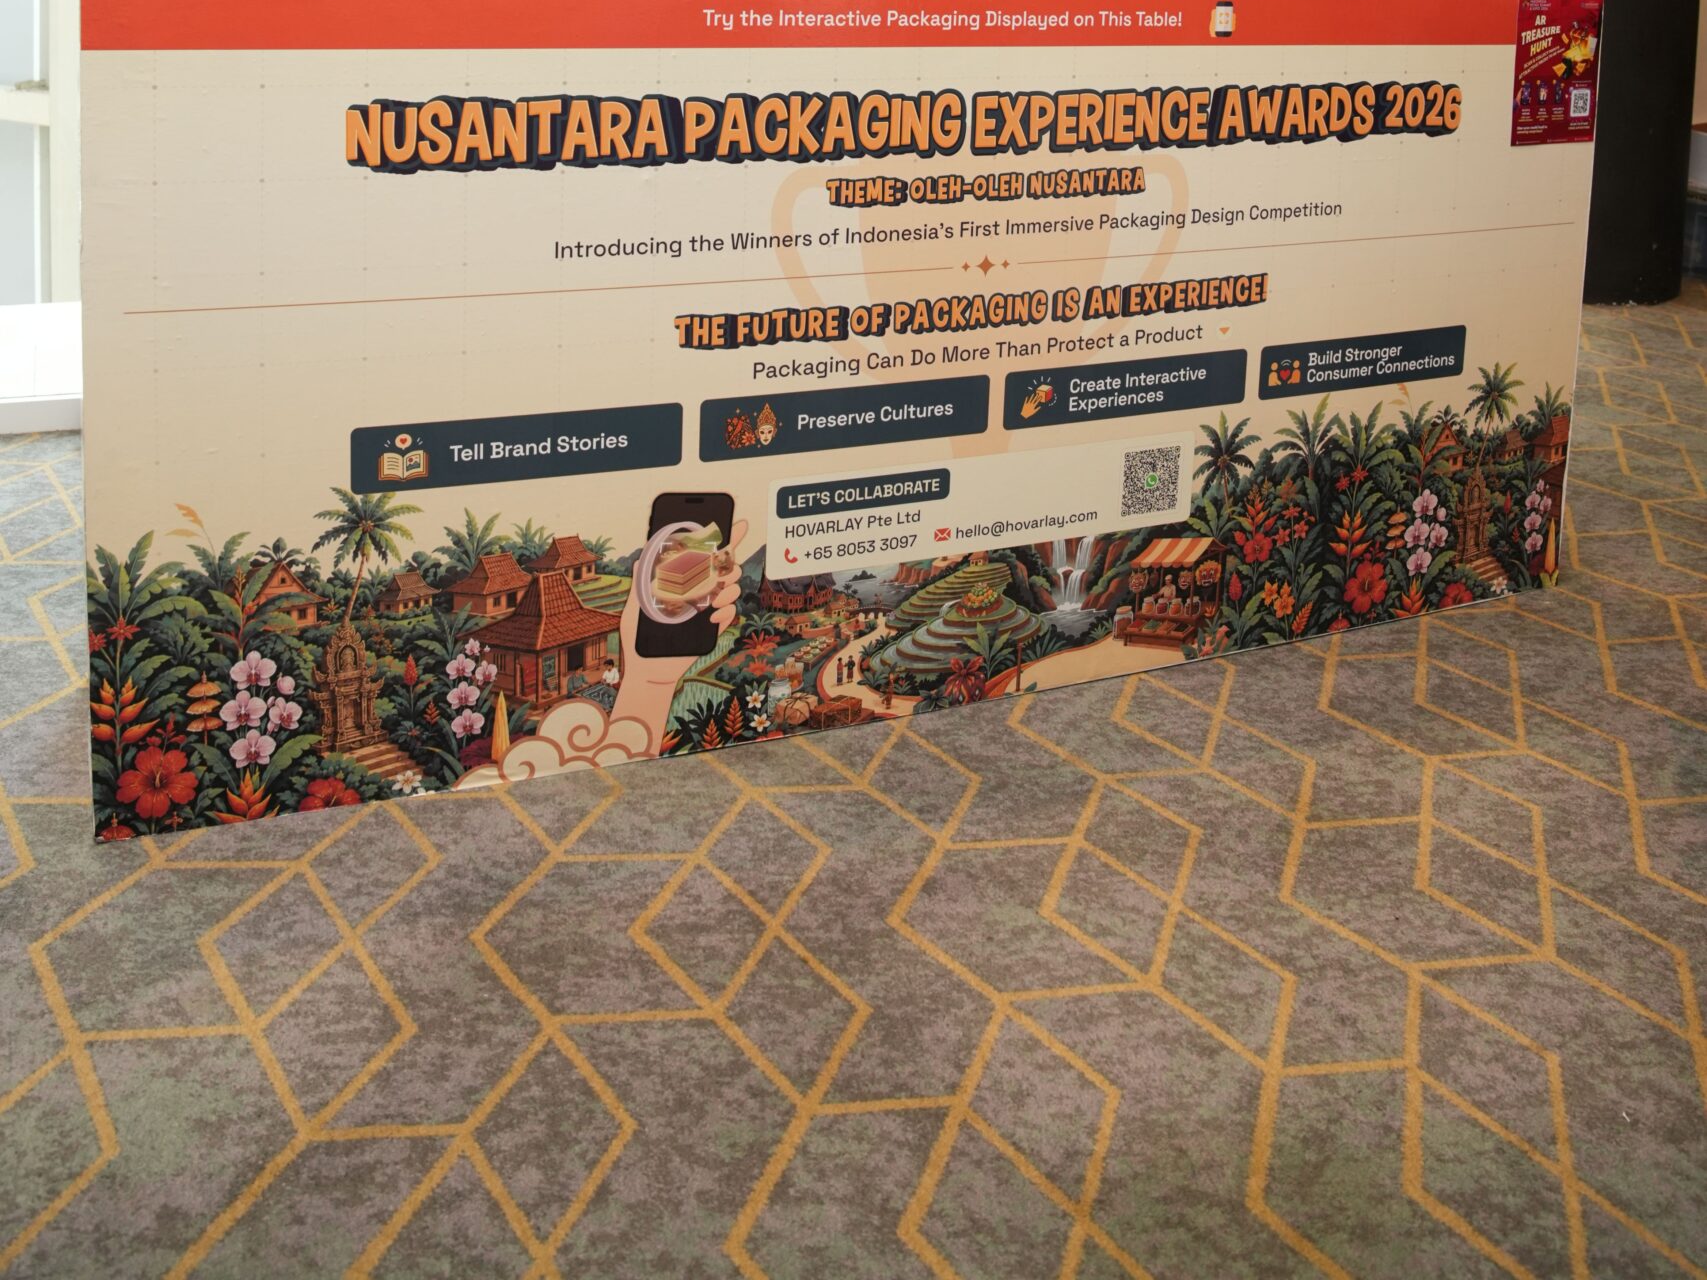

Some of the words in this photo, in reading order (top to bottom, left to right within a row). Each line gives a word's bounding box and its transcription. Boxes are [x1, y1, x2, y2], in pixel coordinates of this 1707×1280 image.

[702, 9, 734, 31] Try
[739, 9, 774, 27] the
[779, 9, 882, 27] Interactive
[887, 10, 980, 31] Packaging
[985, 10, 1069, 31] Displayed
[1073, 14, 1095, 27] on
[1098, 10, 1132, 27] This
[1135, 11, 1182, 27] Table!
[1534, 14, 1547, 26] AR
[1521, 26, 1561, 46] TREASURE
[1529, 37, 1553, 57] HUNT
[345, 94, 682, 173] NUSANTARA
[684, 90, 966, 162] PACKAGING
[970, 86, 1211, 156] EXPERIENCE
[1208, 81, 1377, 147] AWARDS
[1383, 81, 1463, 137] 2026
[826, 177, 907, 207] THEME:
[909, 172, 1025, 202] OLEH-OLEH
[1026, 167, 1146, 200] NUSANTARA
[555, 237, 682, 259] Introducing
[688, 234, 725, 252] the
[730, 232, 813, 250] Winners
[818, 228, 840, 246] of
[845, 222, 954, 244] Indonesia’s
[959, 220, 1001, 238] First
[1005, 215, 1094, 235] Immersive
[1099, 210, 1186, 231] Packaging
[1190, 208, 1245, 226] Design
[1249, 201, 1342, 223] Competition
[674, 314, 737, 350] THE
[735, 306, 848, 346] FUTURE
[850, 303, 891, 336] OF
[893, 290, 1048, 334] PACKAGING
[1050, 287, 1080, 322] IS
[1082, 286, 1121, 320] AN
[1122, 273, 1268, 317] EXPERIENCE!
[753, 356, 860, 380] Packaging
[867, 352, 904, 370] Can
[910, 349, 936, 366] Do
[942, 345, 990, 364] More
[995, 341, 1041, 359] Than
[1047, 333, 1115, 354] Protect
[1119, 334, 1130, 347] a
[1135, 324, 1203, 346] Product
[1307, 349, 1342, 367] Build
[1344, 345, 1403, 362] Stronger
[1069, 376, 1122, 394] Create
[1125, 366, 1207, 388] Interactive
[1306, 365, 1374, 383] Consumer
[1376, 353, 1456, 374] Connections
[1068, 390, 1164, 414] Experiences
[797, 411, 876, 431] Preserve
[880, 403, 954, 422] Cultures
[449, 443, 484, 462] Tell
[490, 437, 551, 459] Brand
[556, 432, 628, 453] Stories
[788, 491, 831, 509] LET’S
[834, 478, 940, 504] COLLABORATE
[785, 516, 863, 539] HOVARLAY
[867, 515, 893, 529] Pte
[896, 509, 921, 525] Ltd
[955, 511, 1098, 539] hello@hovarlay.com
[804, 545, 833, 561] +65
[836, 539, 876, 557] 8053
[879, 534, 918, 552] 3097
